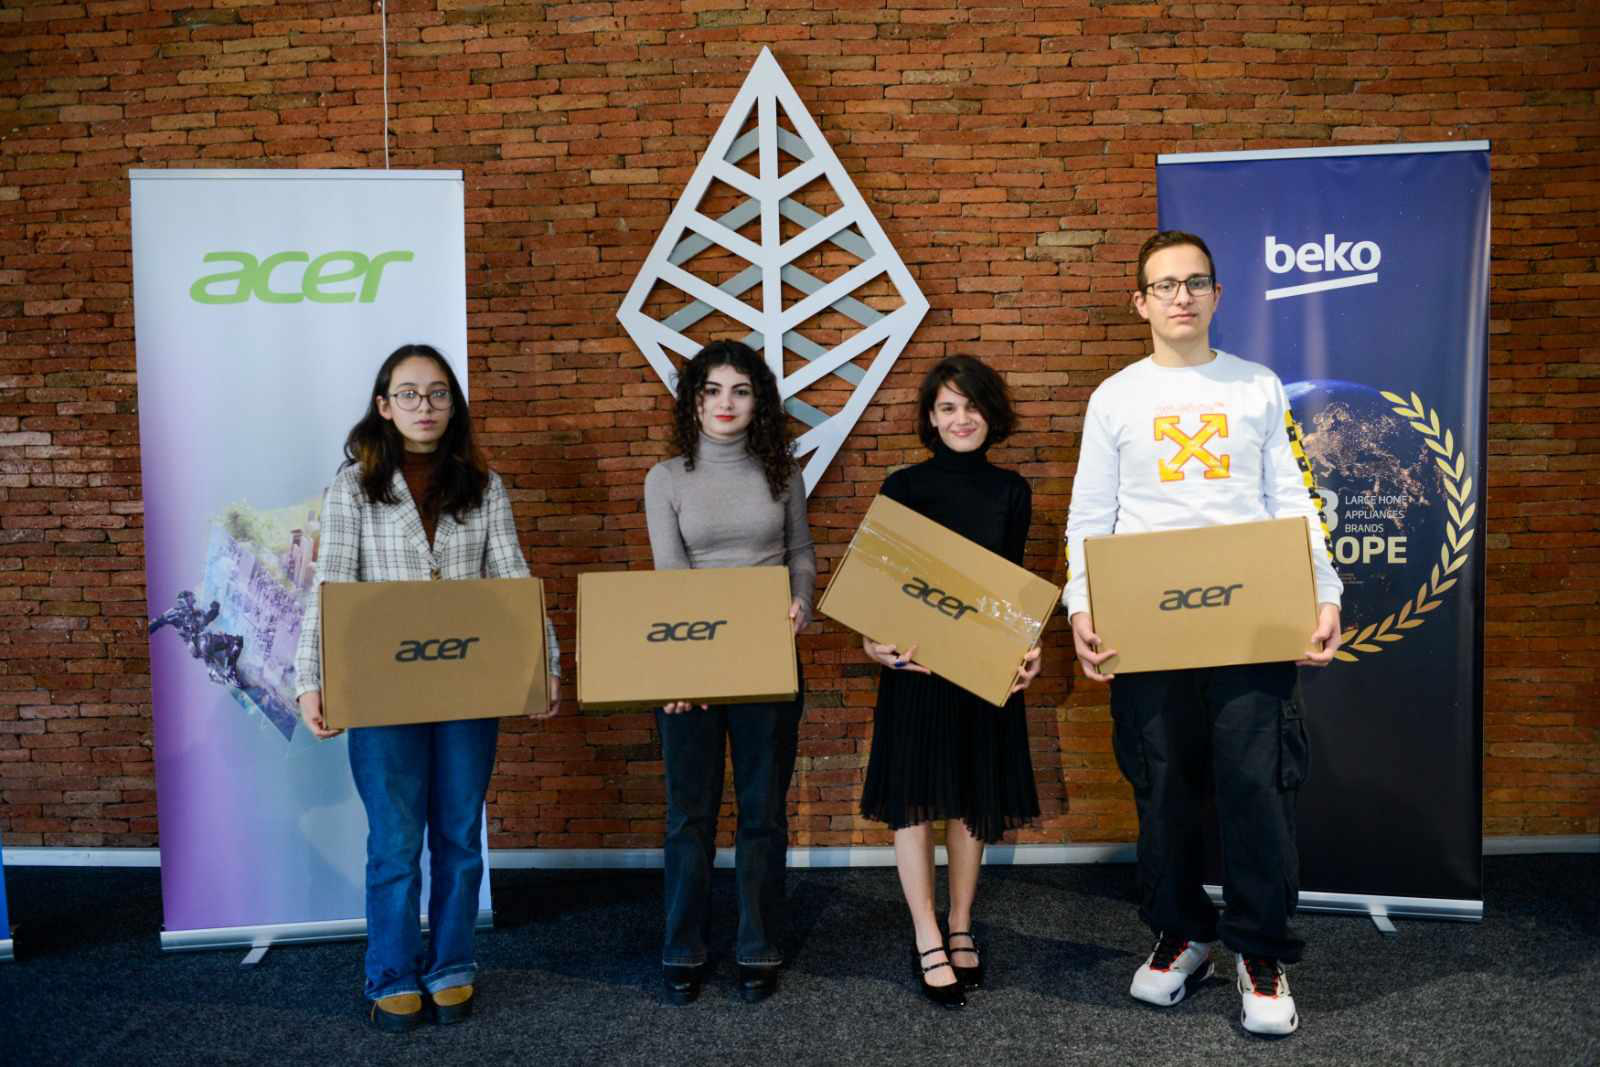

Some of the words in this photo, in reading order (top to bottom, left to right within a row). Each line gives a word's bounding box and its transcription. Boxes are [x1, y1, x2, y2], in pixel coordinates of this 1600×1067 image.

[1265, 233, 1382, 274] beko
[189, 251, 415, 304] acer
[1345, 495, 1377, 505] LARGE
[1378, 495, 1408, 505] HOME
[1344, 510, 1406, 520] APPLIANCES
[1344, 523, 1384, 533] BRANDS
[1335, 535, 1408, 565] OPE
[902, 576, 978, 620] acer
[1159, 584, 1243, 611] acer
[647, 620, 728, 642] acer
[395, 637, 480, 662] acer
